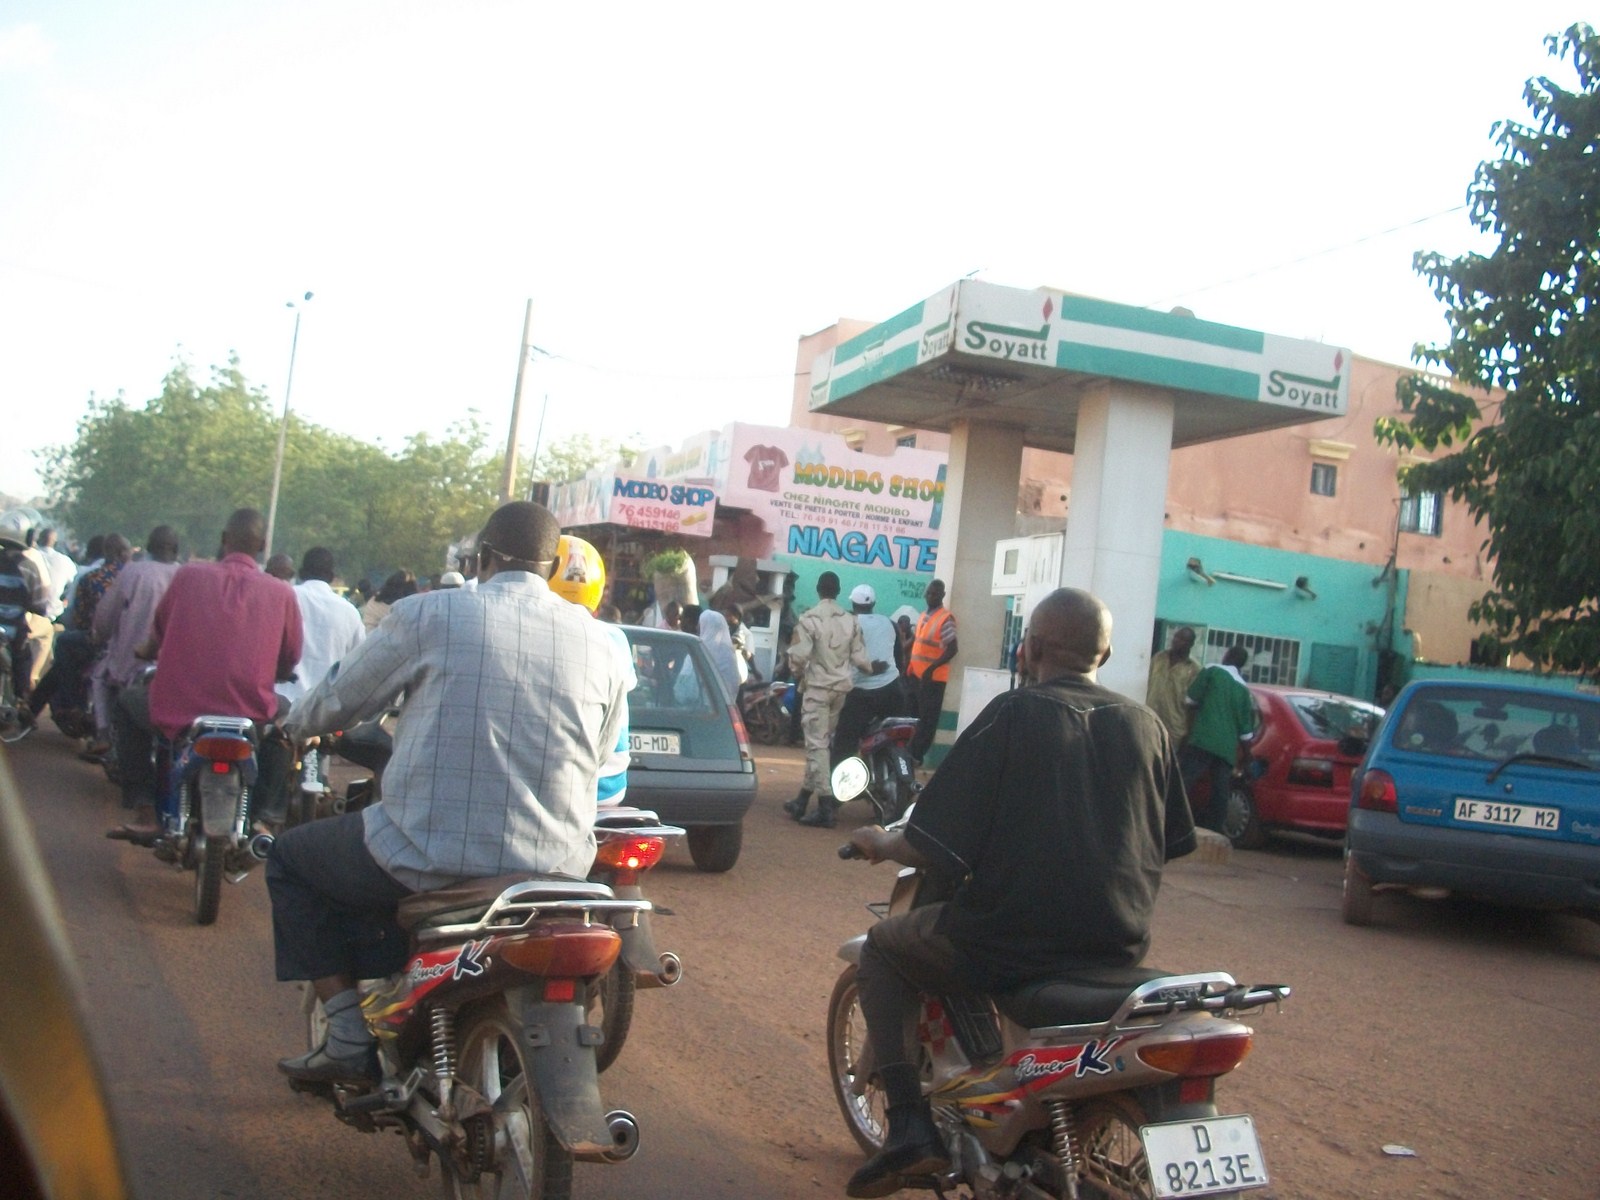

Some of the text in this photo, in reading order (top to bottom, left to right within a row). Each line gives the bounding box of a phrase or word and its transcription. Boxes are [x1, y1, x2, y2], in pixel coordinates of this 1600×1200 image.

[964, 320, 1051, 360] Soyatt
[1267, 369, 1341, 409] Soyatt
[670, 484, 715, 507] SHOP
[793, 462, 884, 495] MODIBO
[770, 499, 793, 509] VENTE
[898, 517, 924, 528] ENFANT
[783, 491, 810, 503] CHEZ
[864, 503, 910, 517] MODIBO
[788, 524, 939, 572] NIAGATE
[1458, 802, 1477, 818] AF
[1483, 804, 1522, 823] 3117
[1534, 810, 1556, 828] M2
[453, 935, 495, 980] K
[1014, 1035, 1123, 1081] Power K
[1192, 1124, 1211, 1153] D
[1165, 1153, 1256, 1192] 8213E
